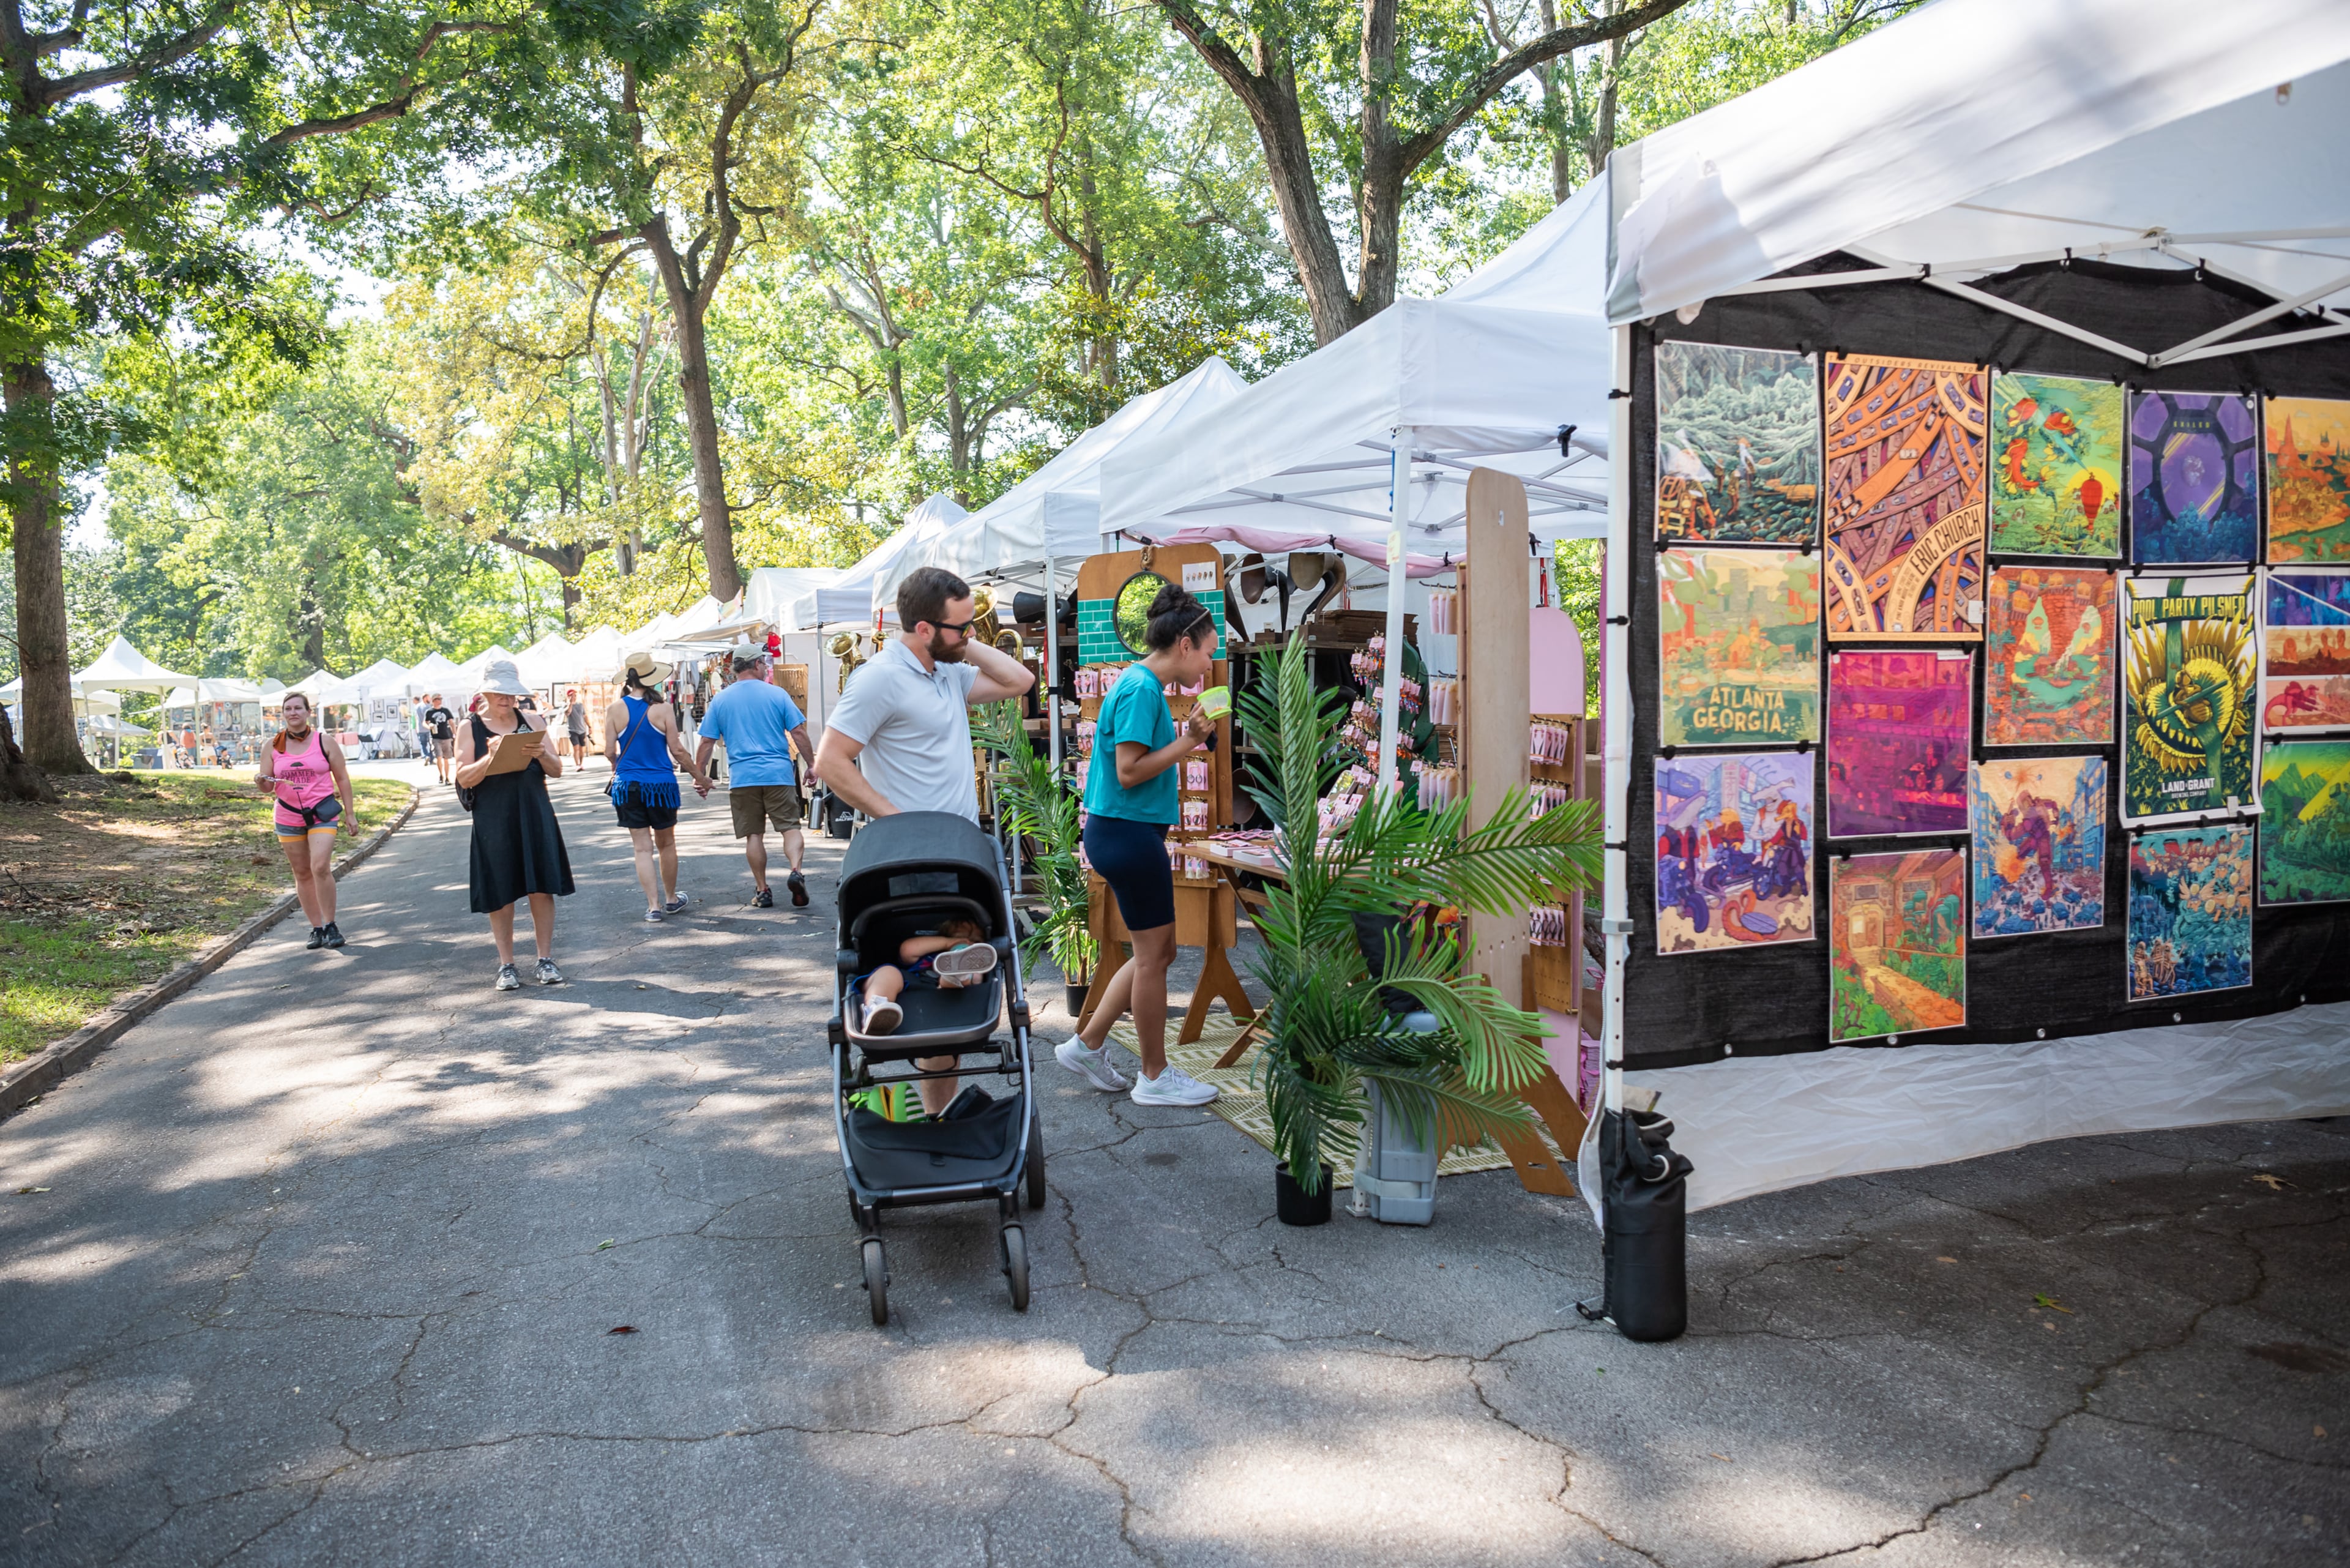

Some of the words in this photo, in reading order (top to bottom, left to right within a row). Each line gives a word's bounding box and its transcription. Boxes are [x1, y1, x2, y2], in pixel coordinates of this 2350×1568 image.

[1854, 357, 1912, 367] OUTSIDERS
[1918, 362, 1958, 371] REVIVAL
[1909, 537, 1939, 575] ERIC
[1934, 508, 1981, 551] CHURCH
[2132, 599, 2157, 625] POOL
[2162, 597, 2196, 618] PARTY
[2201, 595, 2245, 620] PILSNER
[1710, 686, 1785, 710] ATLANTA
[1693, 706, 1782, 733] GEORGIA
[281, 771, 315, 779] SUMMER
